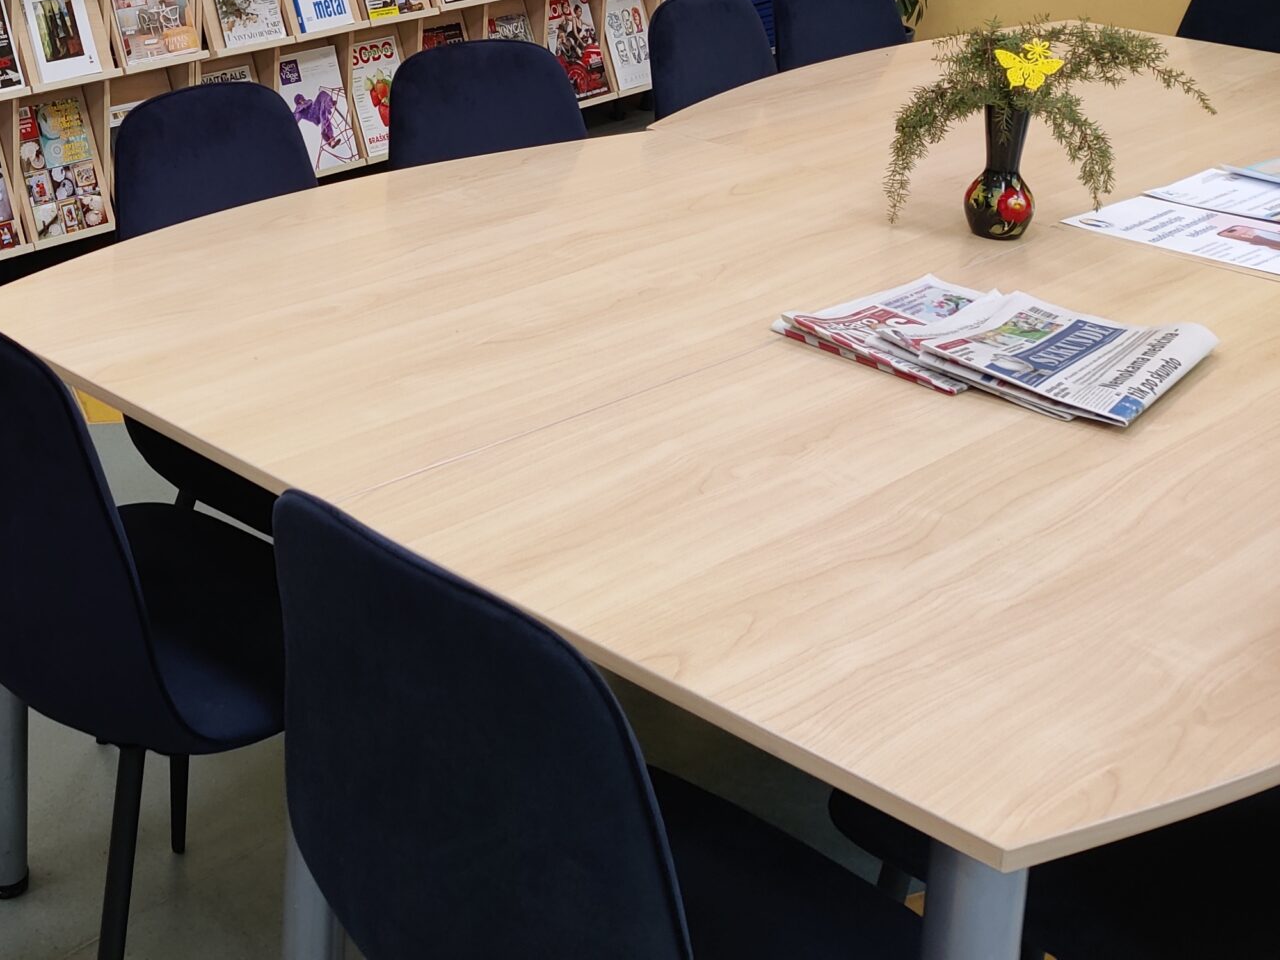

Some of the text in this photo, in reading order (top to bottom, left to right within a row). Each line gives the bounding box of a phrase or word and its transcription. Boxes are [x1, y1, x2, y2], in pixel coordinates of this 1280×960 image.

[352, 42, 394, 67] SODO
[1028, 321, 1115, 368] SEKUNDĖ
[1100, 353, 1150, 391] Nemokama
[1144, 375, 1160, 395] po
[1153, 356, 1183, 385] skundo
